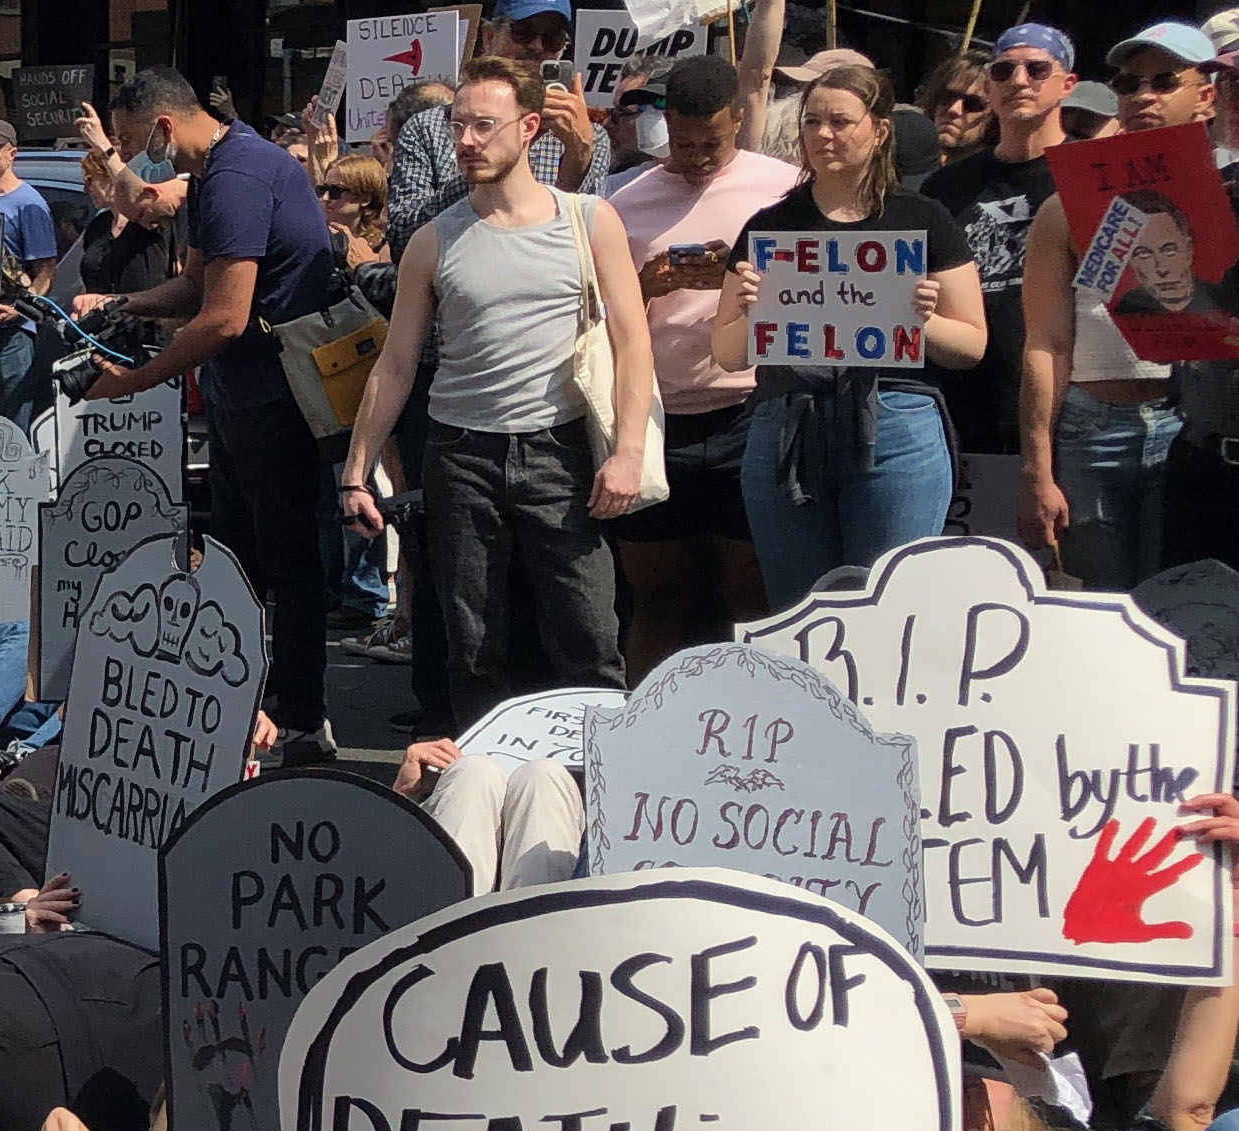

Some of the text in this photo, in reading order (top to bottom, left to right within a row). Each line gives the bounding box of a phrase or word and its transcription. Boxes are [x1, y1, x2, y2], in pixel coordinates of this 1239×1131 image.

[359, 14, 438, 40] SILENCE
[19, 69, 87, 87] HANDS OFF
[359, 73, 452, 100] DEA
[584, 63, 624, 93] TE
[22, 92, 67, 108] SOCIAL
[1076, 200, 1130, 289] MEDICARE
[1096, 261, 1121, 293] FOR
[778, 280, 877, 307] and the
[753, 320, 922, 363] FELON
[78, 411, 163, 438] TRUMP
[83, 439, 164, 459] CLOSED
[81, 501, 142, 533] GOP
[57, 579, 82, 602] my
[101, 655, 221, 734] BLED TO
[527, 706, 583, 725] FIRS
[497, 733, 539, 750] IN
[548, 725, 583, 740] DE
[695, 708, 795, 764] RIP
[89, 707, 215, 793] DEATH
[922, 725, 1025, 828] ED
[57, 761, 188, 850] MISCARRIA
[270, 820, 340, 865] NO
[623, 791, 895, 869] NO SOCIAL
[231, 870, 390, 934] PARK
[180, 942, 360, 1002] RANG
[383, 936, 871, 1079] CAUSE OF
